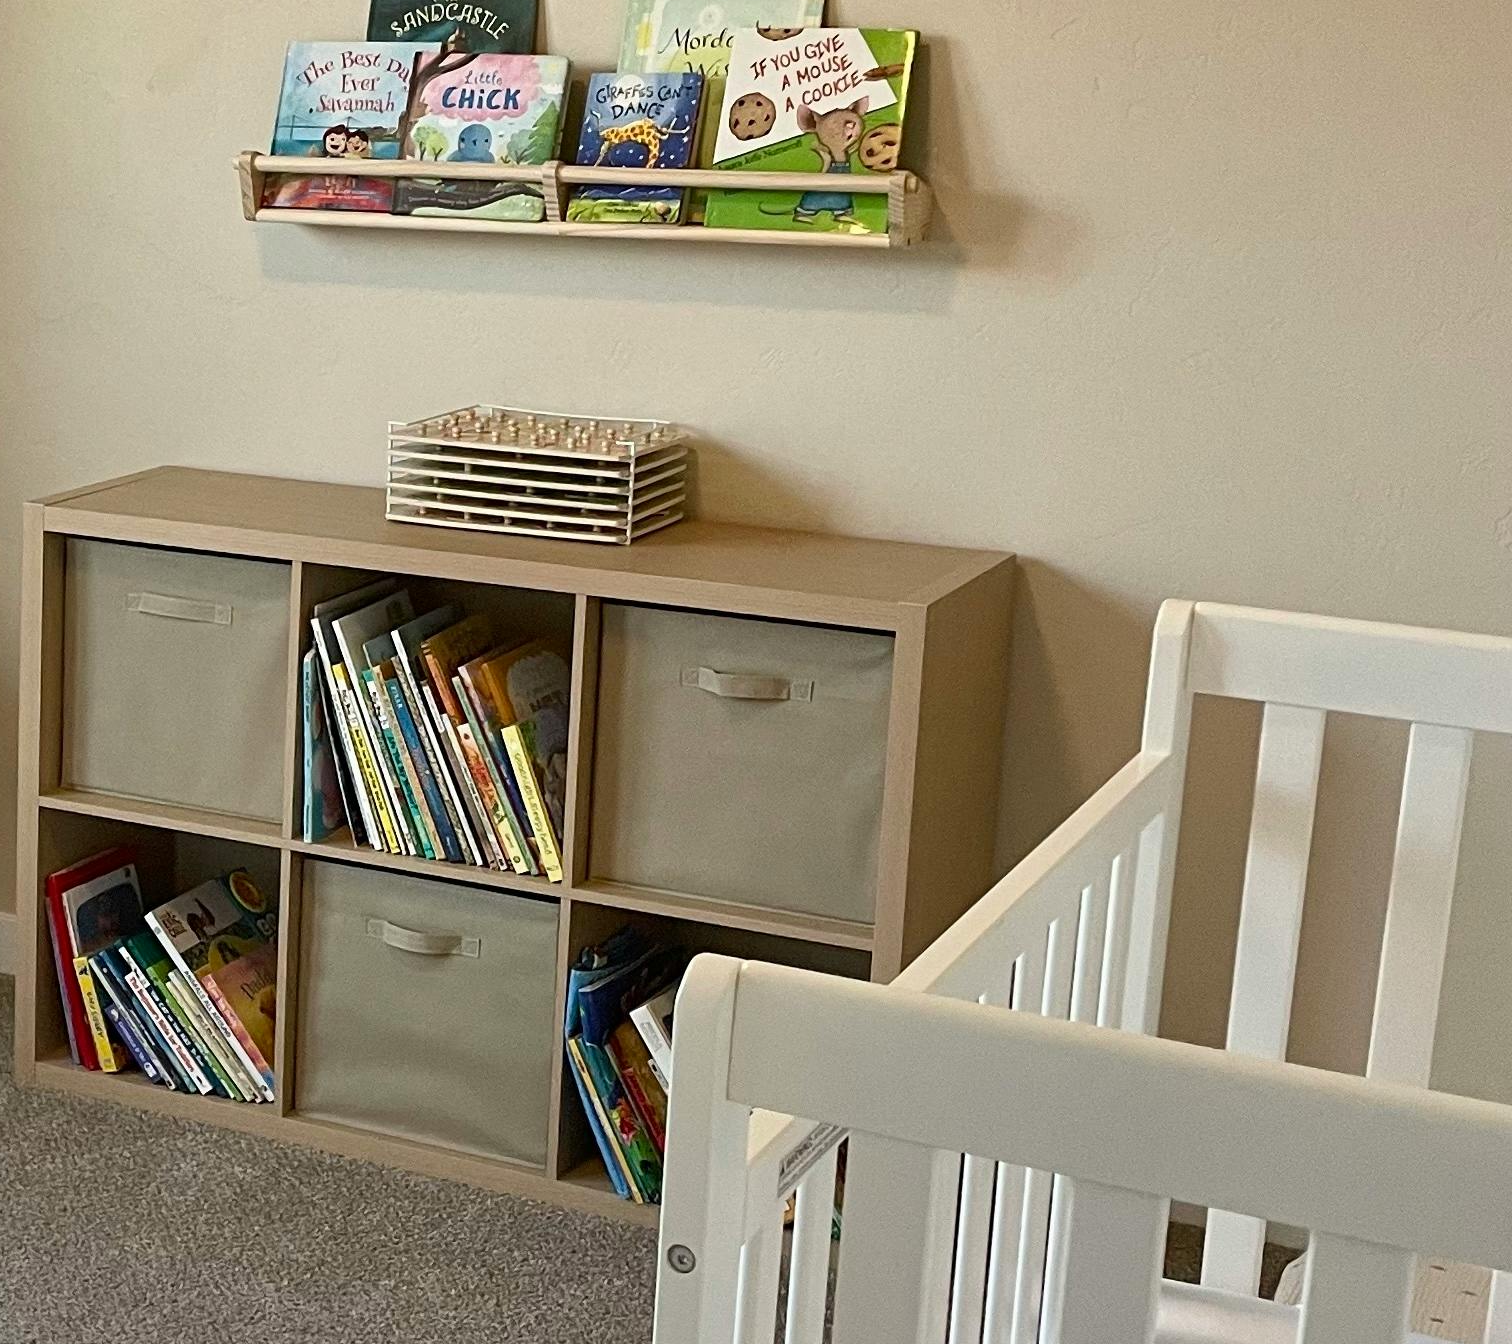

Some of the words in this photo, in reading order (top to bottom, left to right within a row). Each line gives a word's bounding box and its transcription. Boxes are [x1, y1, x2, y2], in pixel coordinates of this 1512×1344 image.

[390, 1, 510, 40] SANDCASTLE
[296, 60, 335, 88] The
[340, 50, 382, 69] Best
[750, 58, 767, 81] IF
[770, 46, 800, 72] YOU
[804, 33, 845, 60] GIVE
[781, 74, 791, 92] A
[796, 53, 853, 86] MOUSE
[340, 73, 381, 94] Ever
[463, 69, 503, 86] Little
[785, 96, 795, 113] A
[802, 70, 863, 106] COOKIE
[316, 91, 396, 114] Savannah
[611, 101, 665, 120] DANCE
